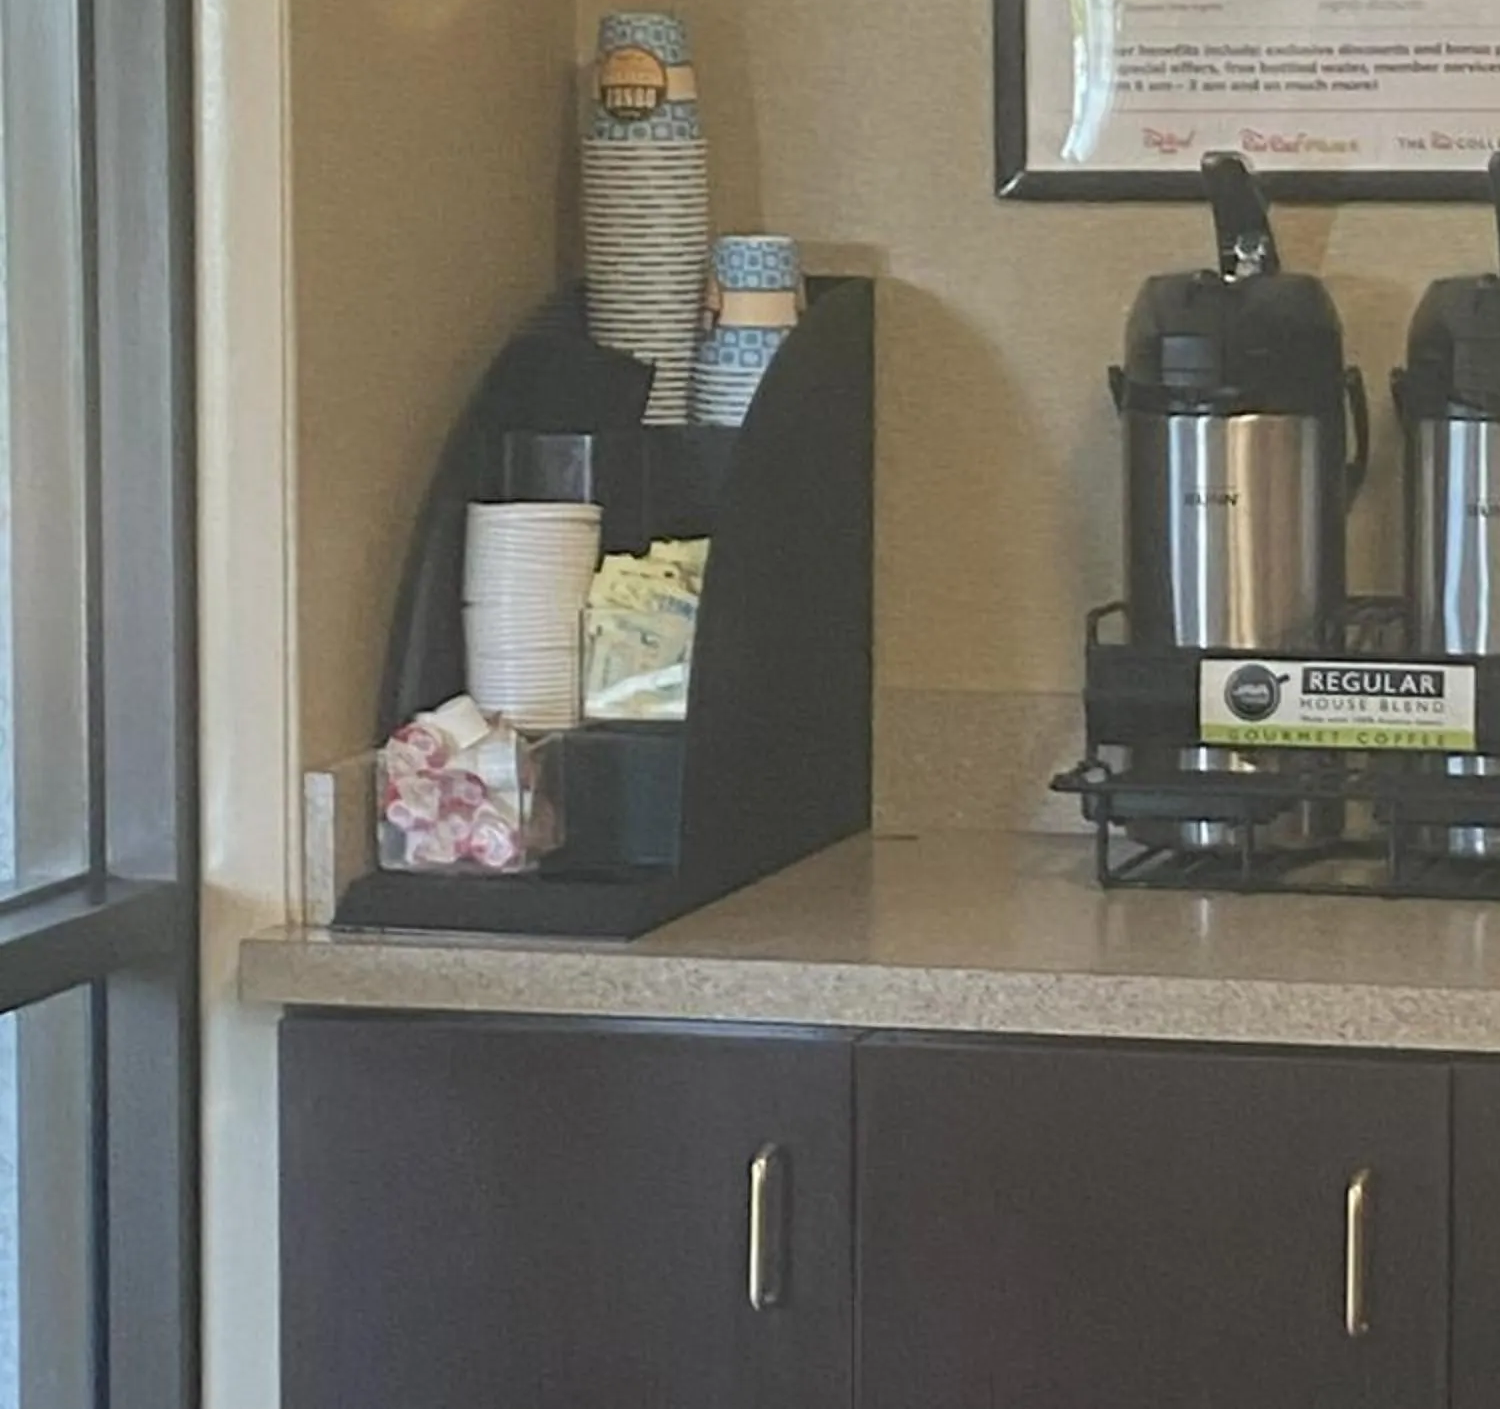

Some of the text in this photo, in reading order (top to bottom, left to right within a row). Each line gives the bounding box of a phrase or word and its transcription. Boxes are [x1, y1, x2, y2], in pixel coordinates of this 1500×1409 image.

[1309, 670, 1436, 694] REGULAR
[1301, 697, 1445, 714] HOUSE BLEND
[1228, 727, 1445, 746] GOURMET COFFEE
